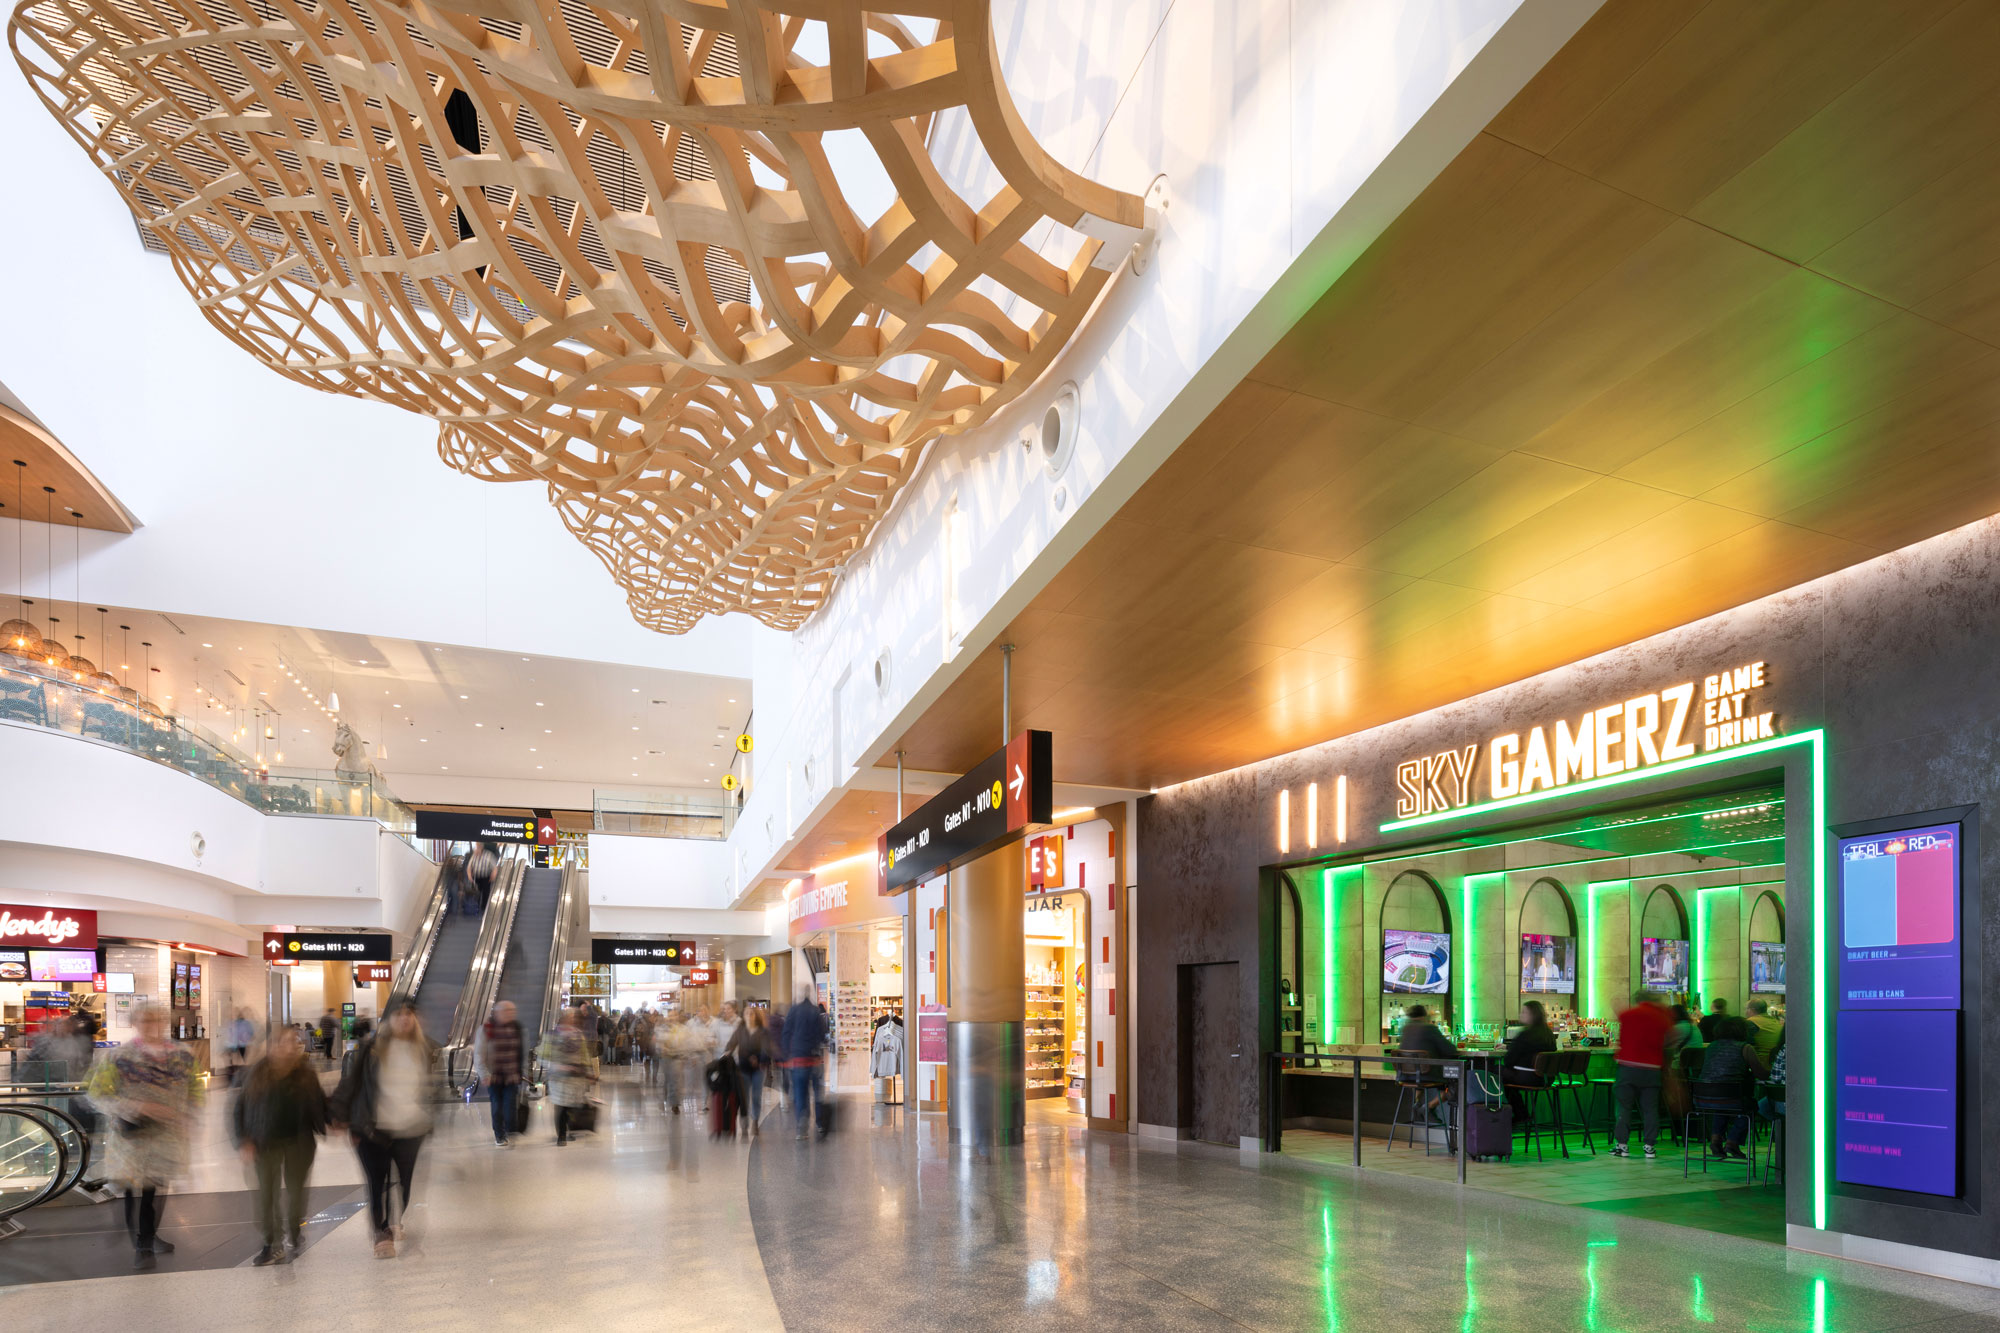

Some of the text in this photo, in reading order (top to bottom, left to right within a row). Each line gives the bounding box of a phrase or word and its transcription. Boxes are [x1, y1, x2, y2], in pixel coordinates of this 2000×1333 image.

[1704, 661, 1765, 701] GAME
[1704, 693, 1746, 727] EAT
[1704, 711, 1774, 753] DRINK
[1397, 681, 1696, 819] SKY GAMERZ
[944, 811, 962, 833] Gates
[962, 801, 971, 822] N1
[976, 788, 991, 814] N10
[481, 829, 524, 839] Alaska Lounge
[894, 845, 907, 862] Gates
[906, 836, 916, 856] N11
[919, 828, 930, 848] N20
[1850, 843, 1884, 856] TEAL
[1909, 836, 1936, 850] RED
[820, 880, 849, 912] EMPIRE
[1028, 897, 1063, 912] JAR
[301, 942, 326, 952] Gates
[326, 943, 342, 952] N11
[348, 943, 365, 953] N20
[614, 948, 635, 956] Gates
[634, 949, 648, 957] N11
[652, 949, 667, 957] N20
[1847, 952, 1869, 960] DRAFT
[1870, 950, 1889, 959] BEER
[370, 968, 390, 979] N11
[692, 972, 710, 981] N20
[1885, 989, 1905, 998] CANS
[1868, 1113, 1884, 1121] WINE
[1884, 1148, 1902, 1156] WINE
